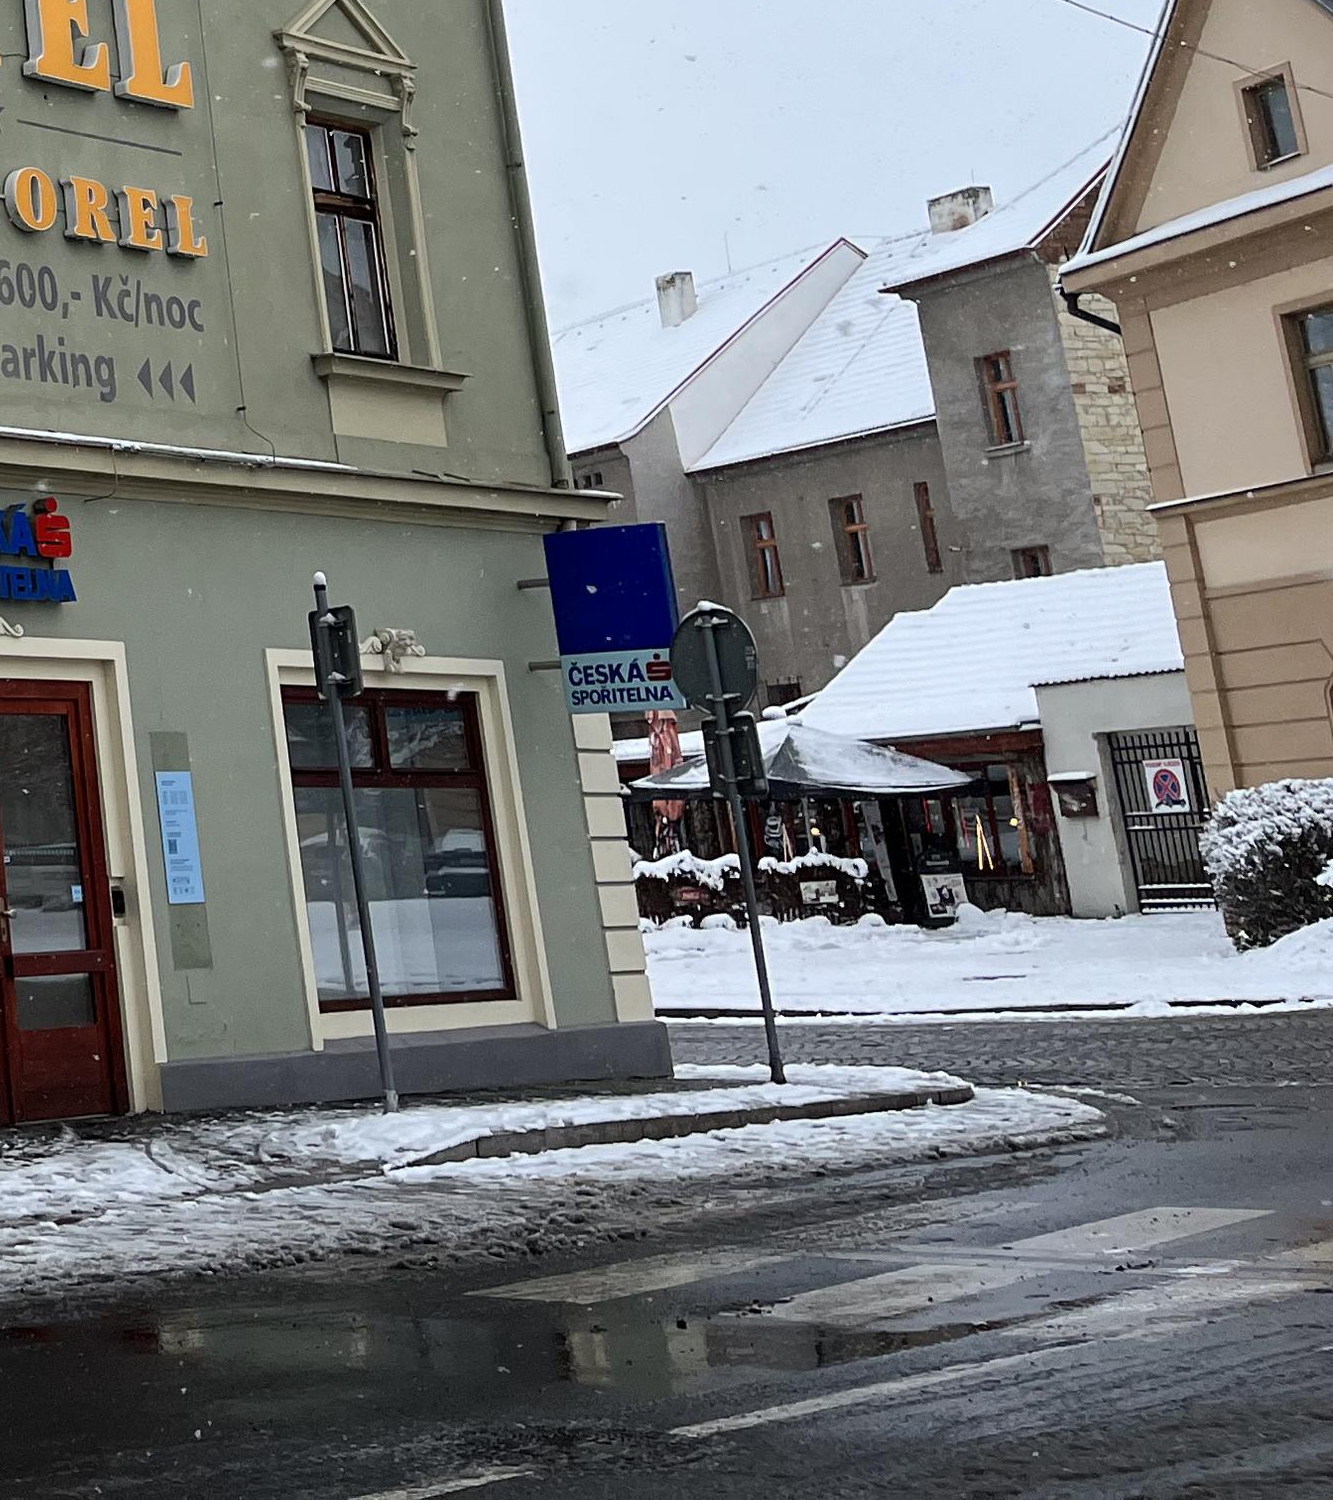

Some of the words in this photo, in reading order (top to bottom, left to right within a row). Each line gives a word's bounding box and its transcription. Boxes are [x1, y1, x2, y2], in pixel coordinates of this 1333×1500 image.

[5, 167, 208, 257] OREL
[92, 274, 205, 332] Kč/noc
[568, 658, 646, 687] ČESKÁ
[571, 684, 675, 706] SPOŘITELNA
